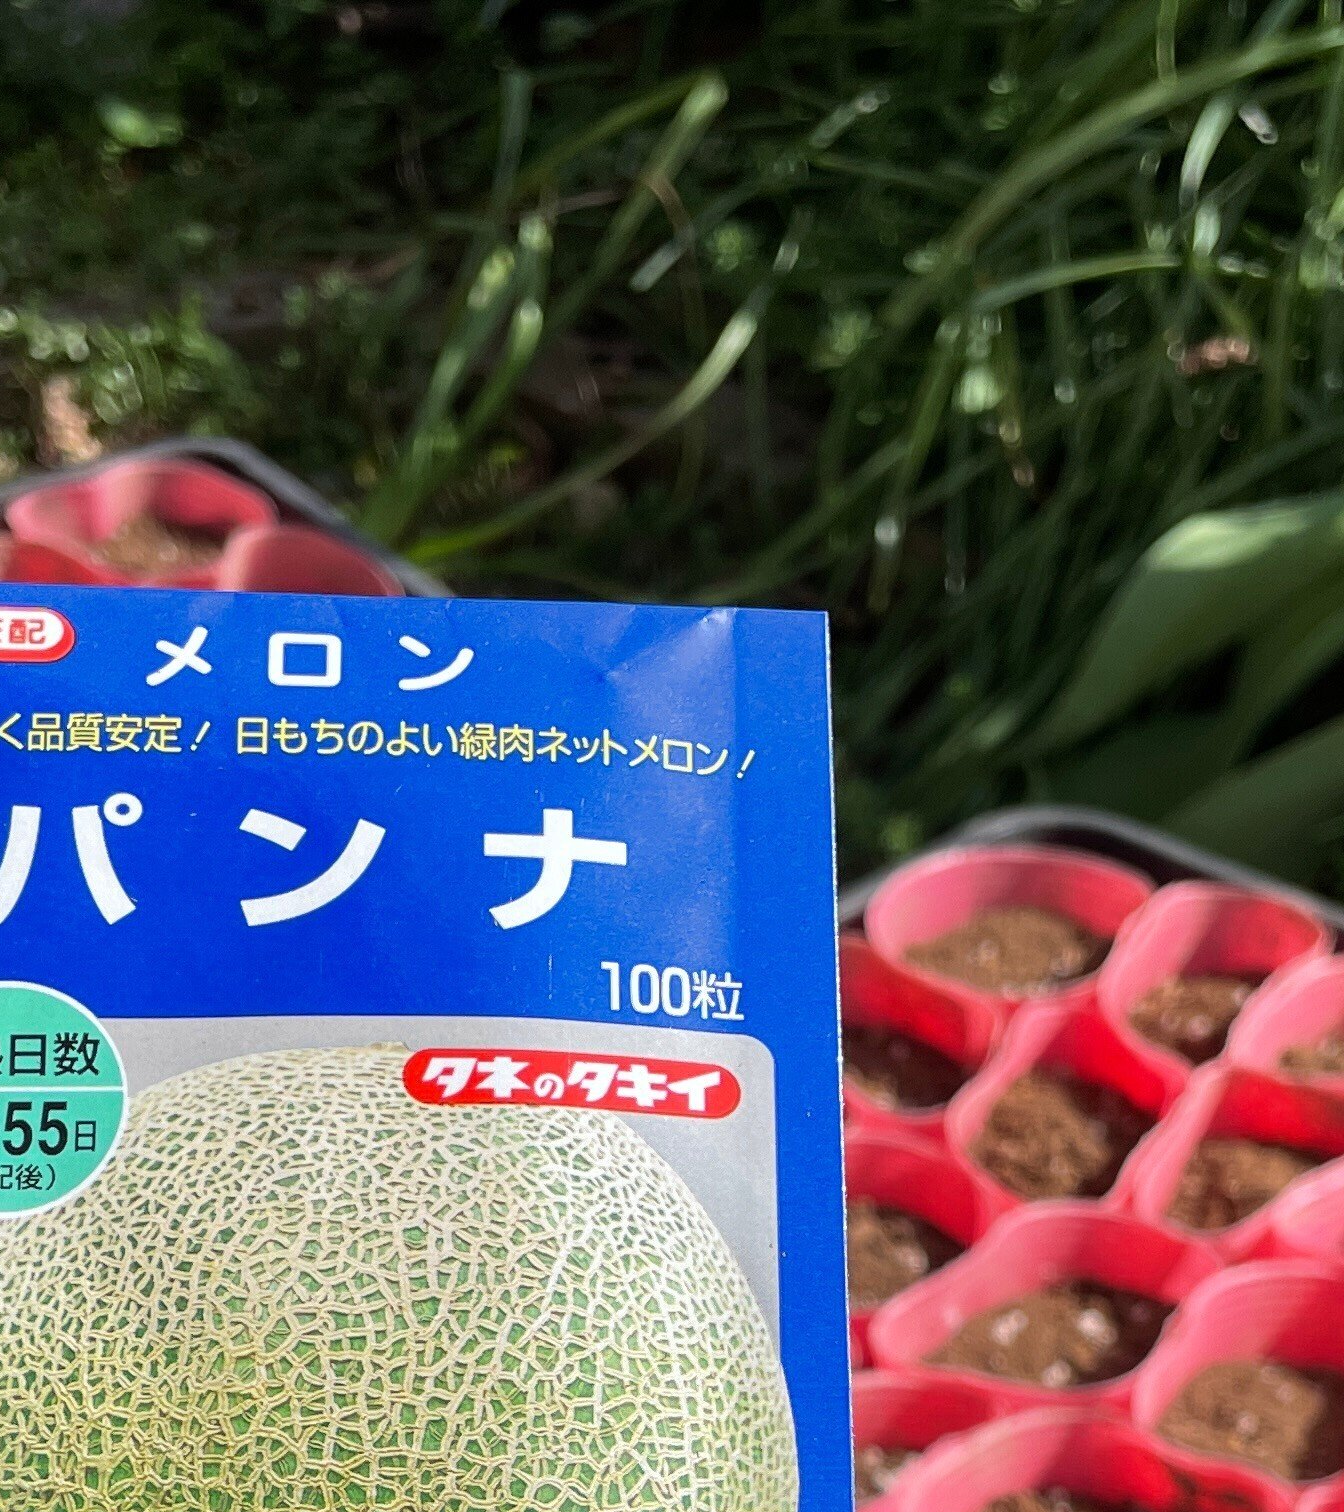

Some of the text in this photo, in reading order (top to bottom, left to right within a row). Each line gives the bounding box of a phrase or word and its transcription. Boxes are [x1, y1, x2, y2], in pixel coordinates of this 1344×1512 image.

[146, 626, 474, 691] メロン
[600, 961, 745, 1021] 100粒
[423, 1057, 721, 1111] タネのタキイ
